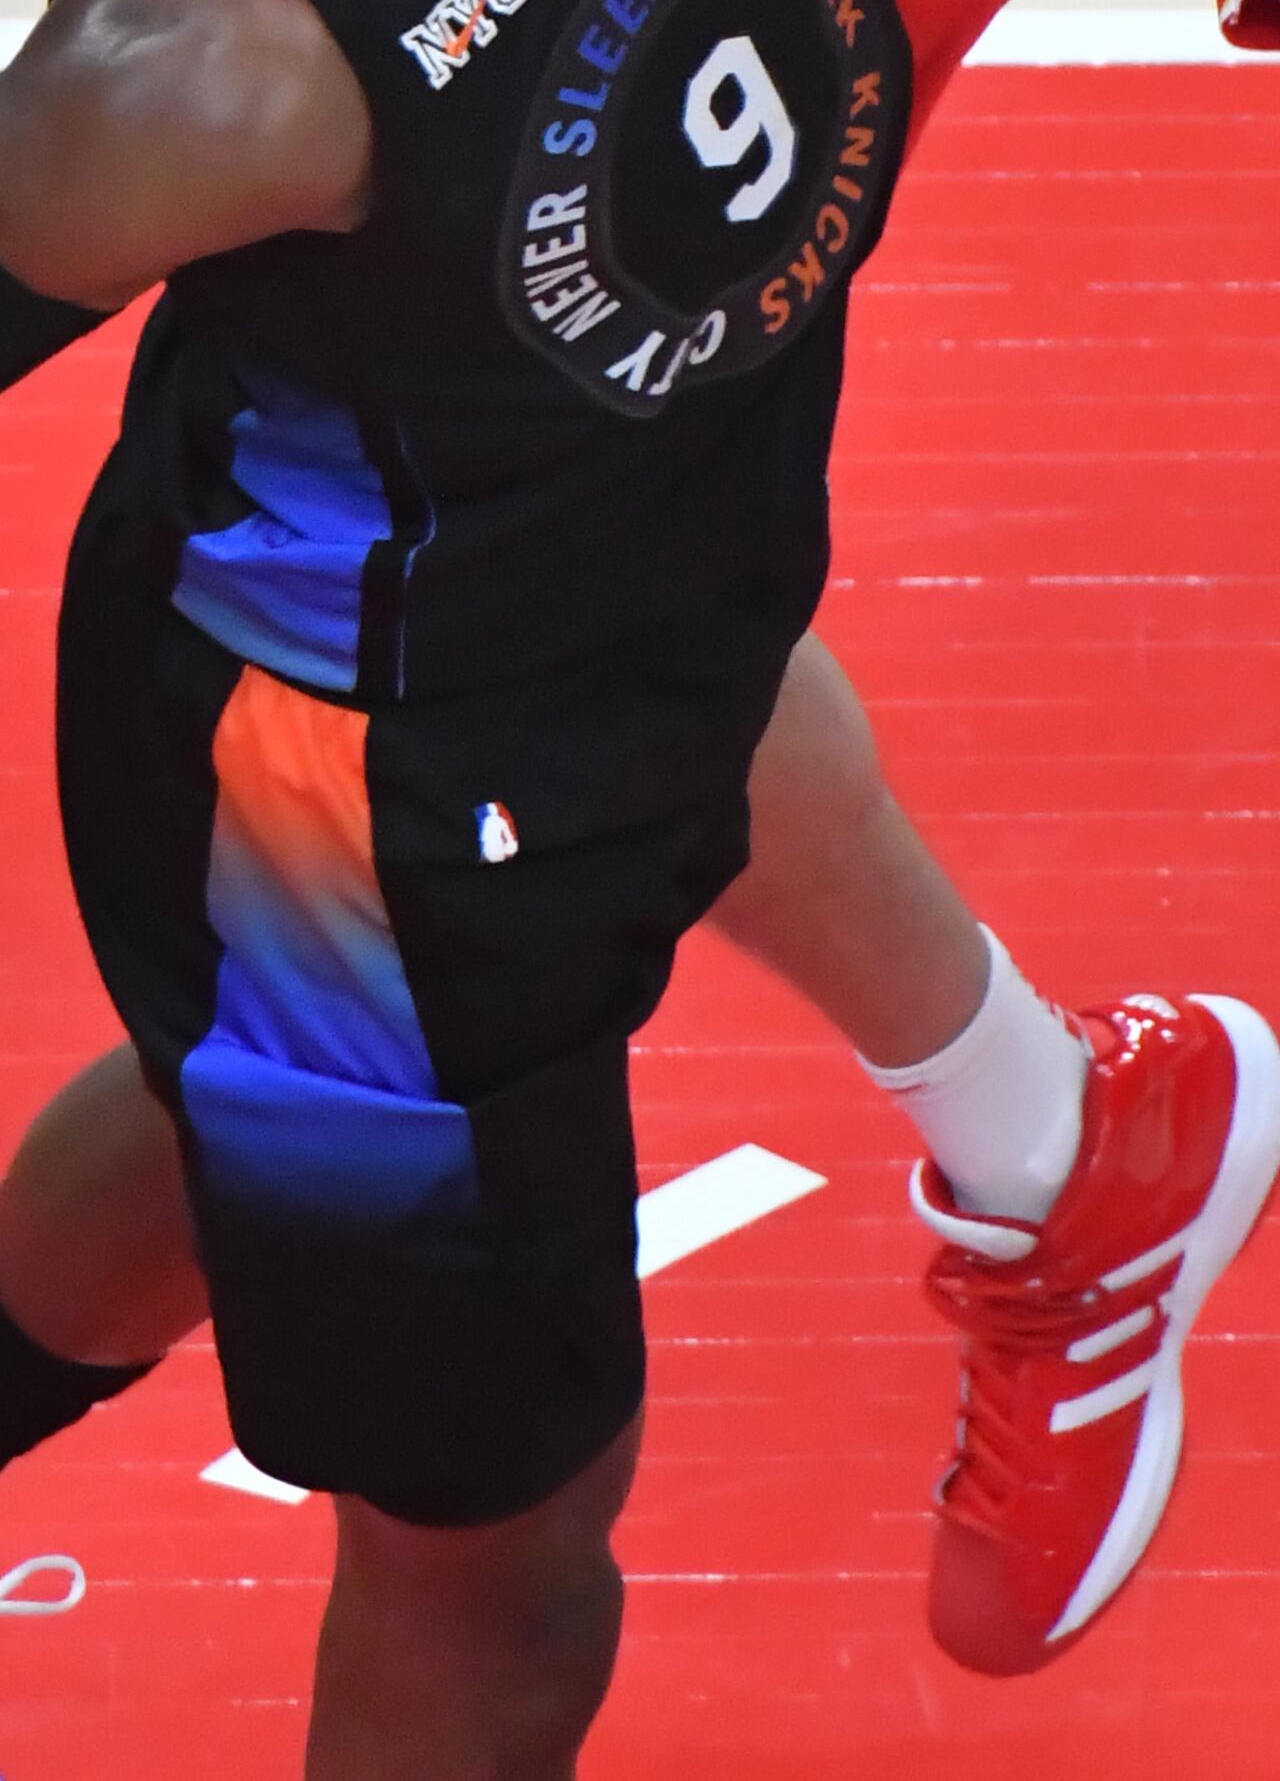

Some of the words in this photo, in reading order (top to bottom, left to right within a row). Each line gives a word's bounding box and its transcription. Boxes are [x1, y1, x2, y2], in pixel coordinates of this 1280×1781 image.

[521, 183, 622, 343] NEVER
[758, 69, 882, 335] KNICKS
[682, 35, 798, 224] 9
